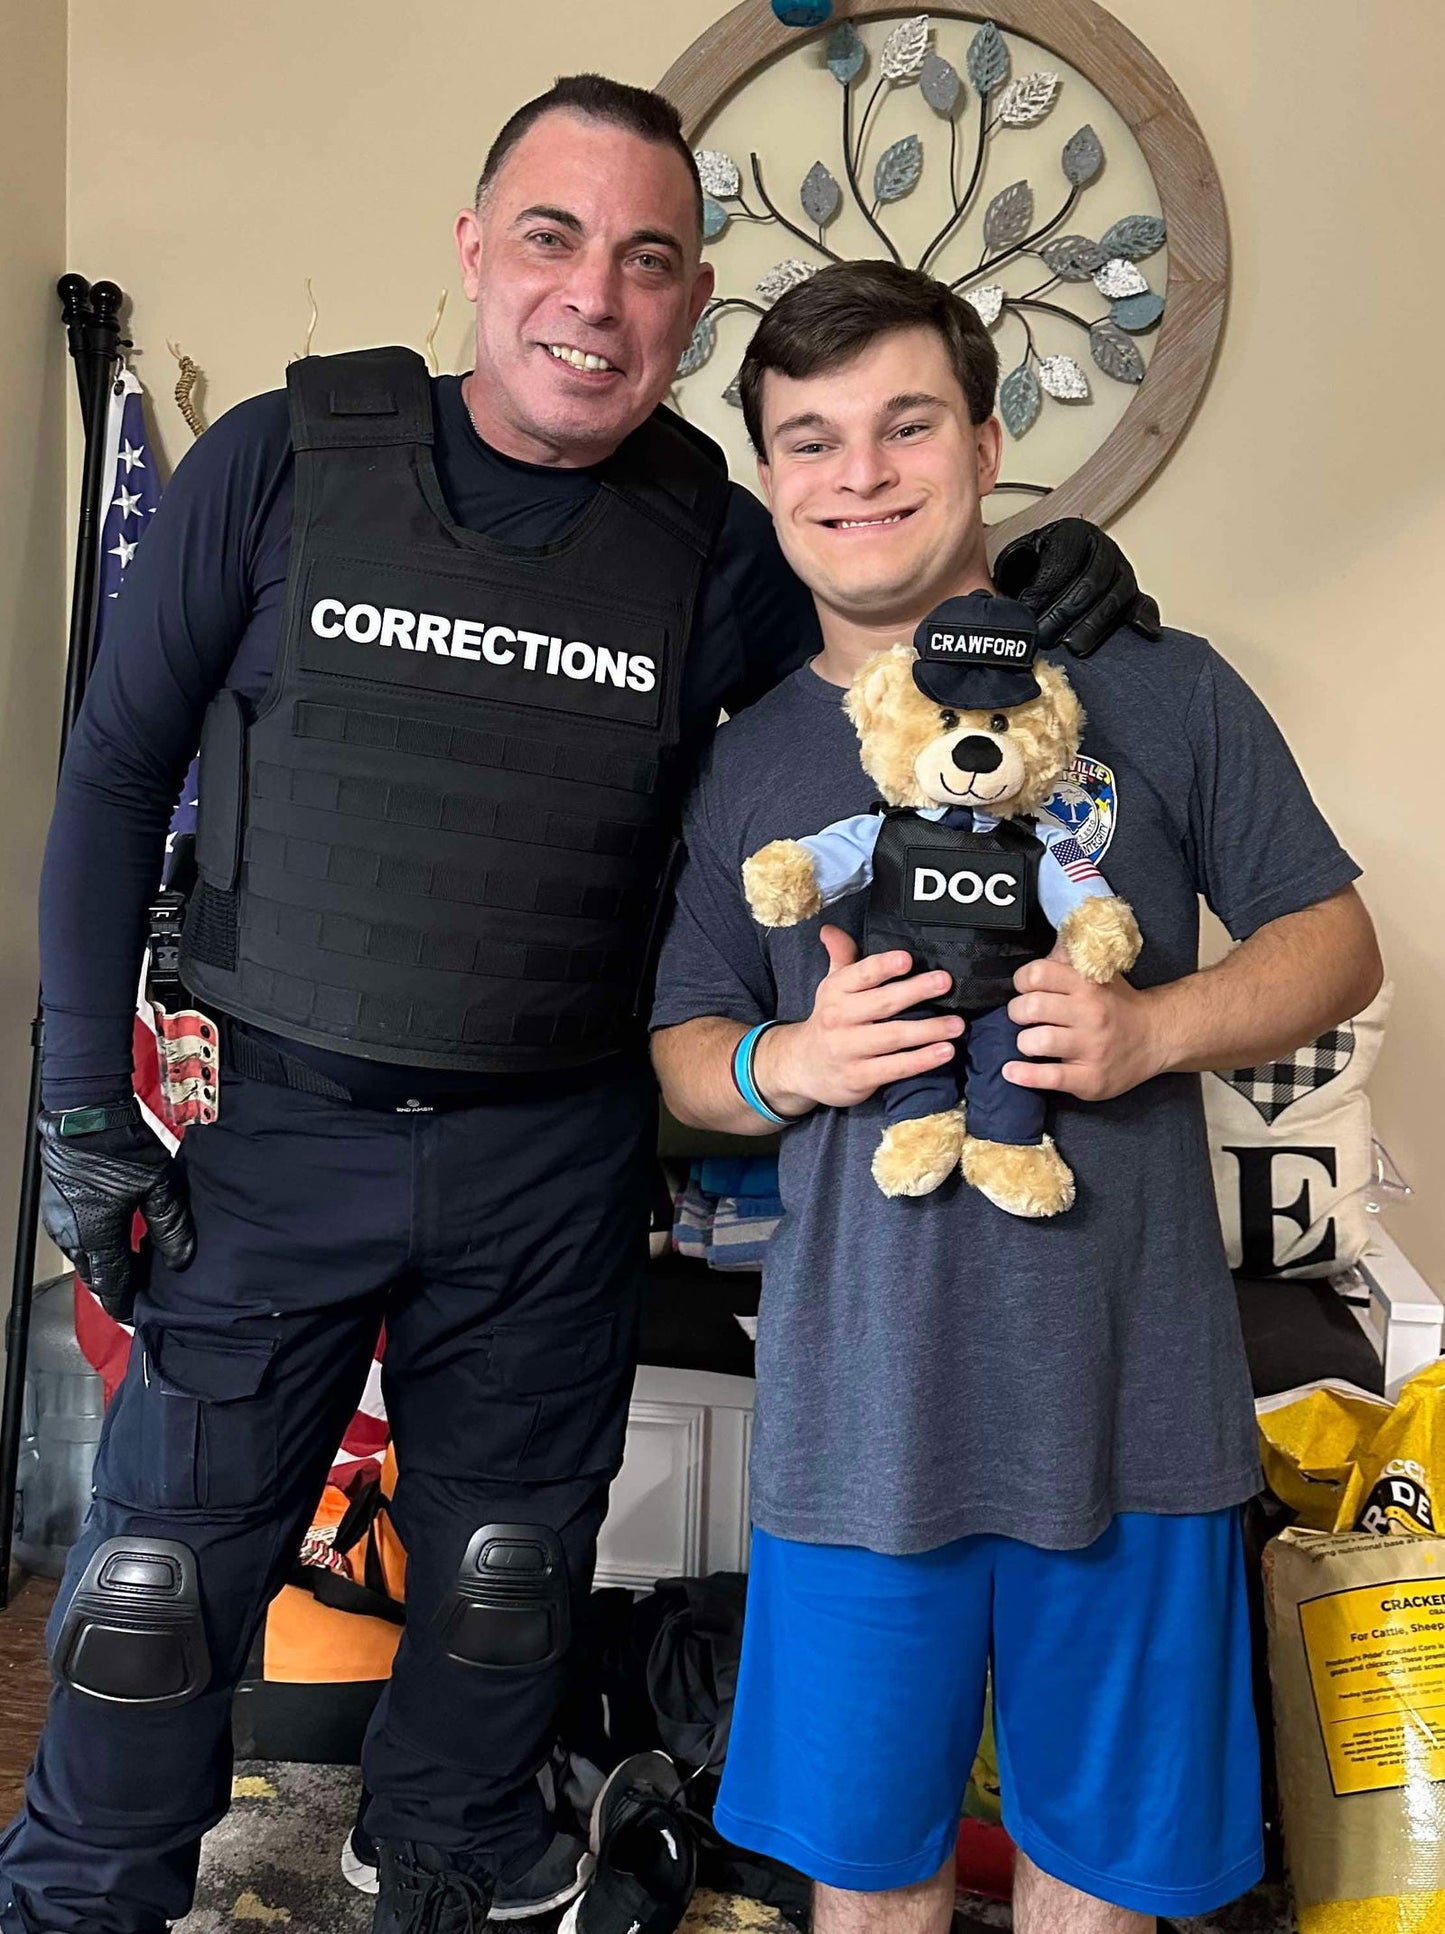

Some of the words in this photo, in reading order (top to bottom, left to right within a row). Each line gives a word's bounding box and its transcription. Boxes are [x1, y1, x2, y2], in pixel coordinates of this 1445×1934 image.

[310, 598, 656, 692] CORRECTIONS
[930, 633, 1027, 658] CRAWFORD
[1062, 770, 1087, 784] ICE
[1070, 760, 1104, 781] VILLE
[1081, 822, 1109, 856] NTEGRITY
[913, 867, 1016, 906] DOC
[1221, 1145, 1337, 1277] E
[1384, 1540, 1405, 1548] base
[1350, 1632, 1368, 1643] For
